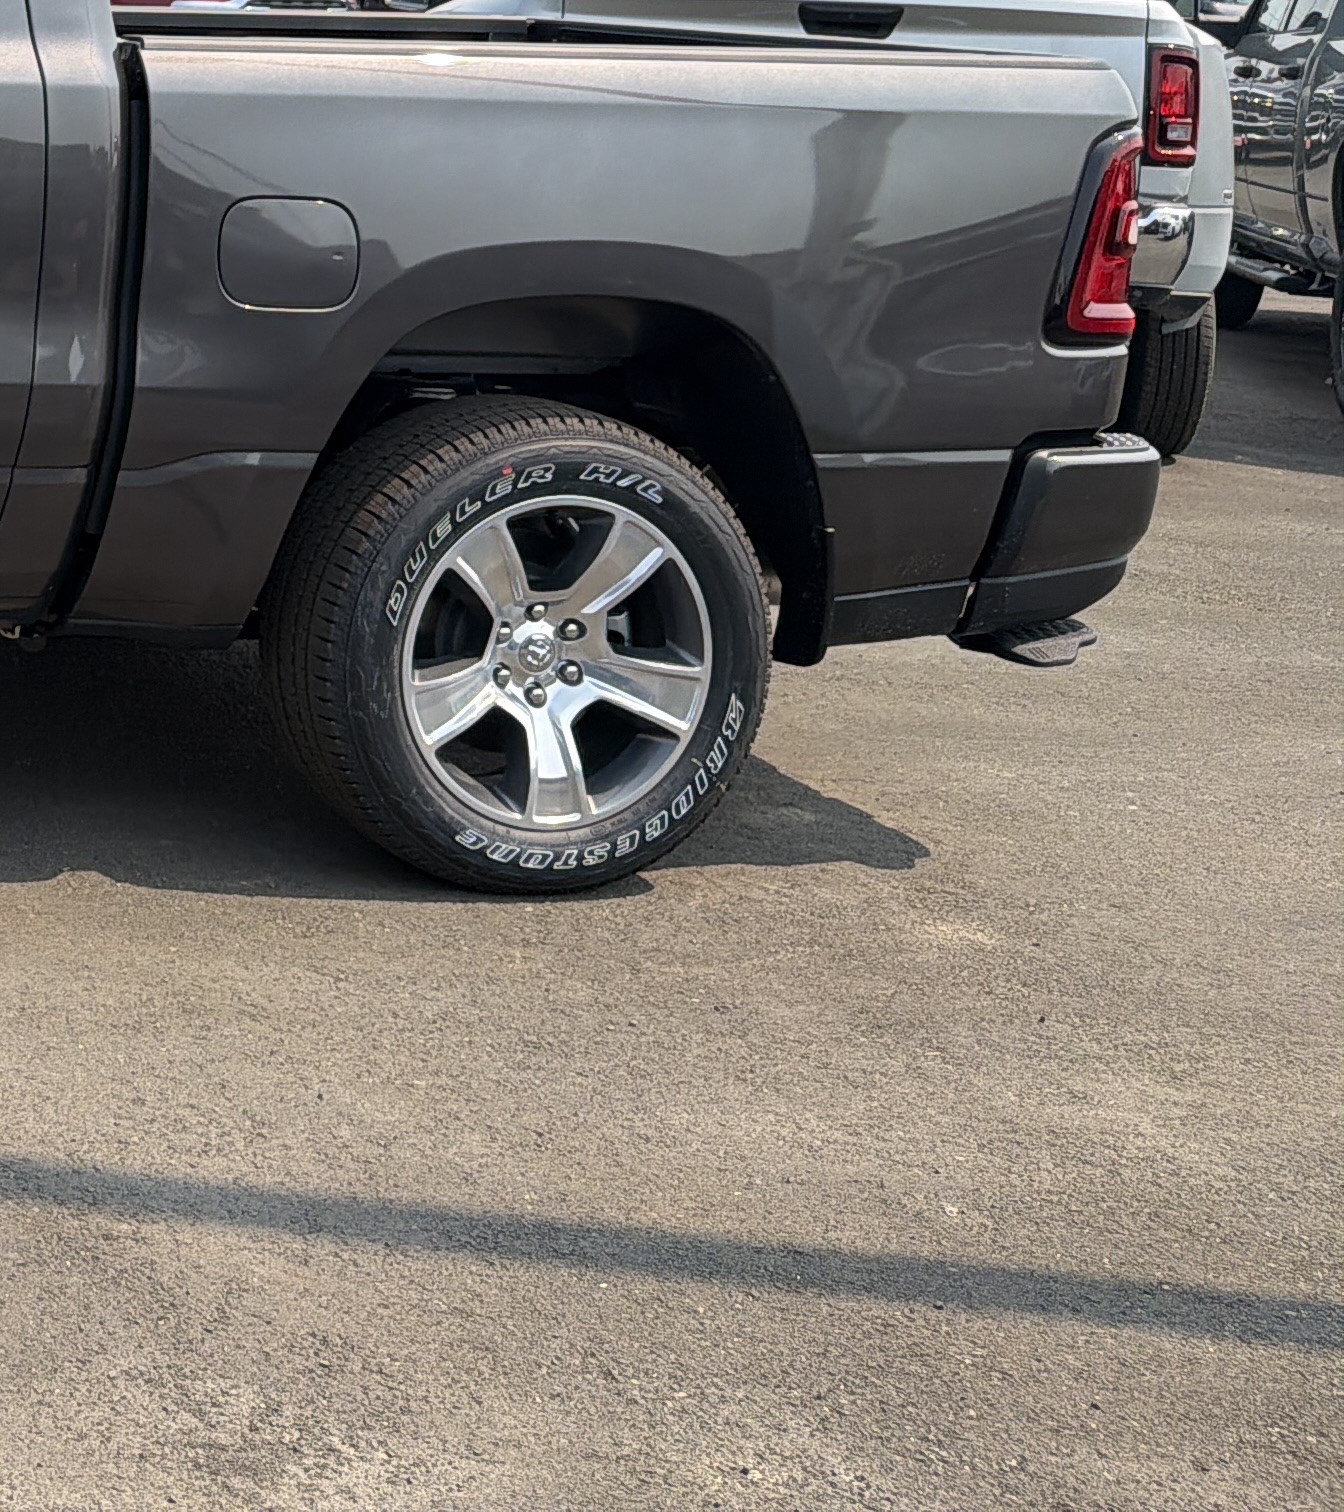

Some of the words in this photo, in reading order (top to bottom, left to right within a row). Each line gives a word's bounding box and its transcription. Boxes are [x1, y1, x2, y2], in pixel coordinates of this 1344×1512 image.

[385, 462, 555, 627] DUELER
[579, 462, 666, 504] H/L
[455, 693, 745, 870] BRIDGESTONE
